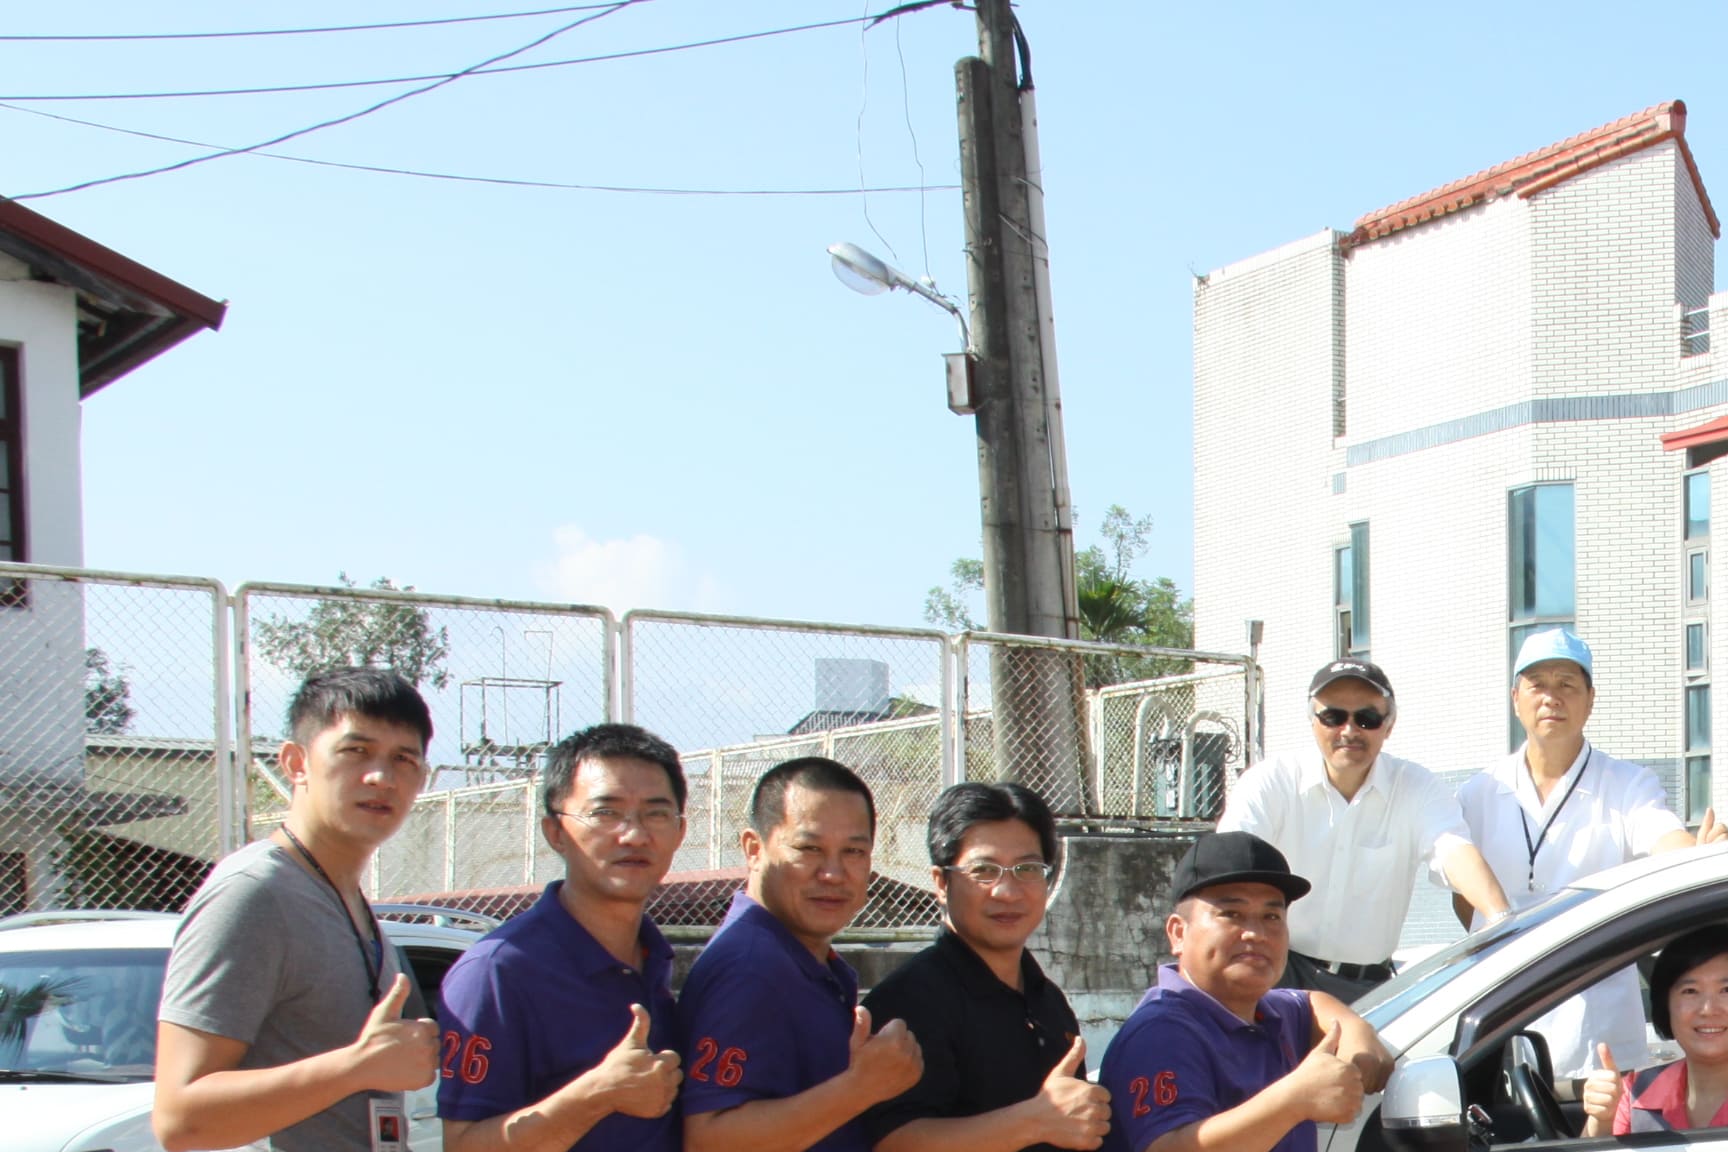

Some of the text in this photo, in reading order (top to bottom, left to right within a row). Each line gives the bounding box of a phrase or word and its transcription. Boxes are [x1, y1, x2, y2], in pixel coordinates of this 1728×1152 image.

[442, 1031, 491, 1085] 26
[689, 1037, 748, 1088] 26
[1129, 1071, 1178, 1119] 26
